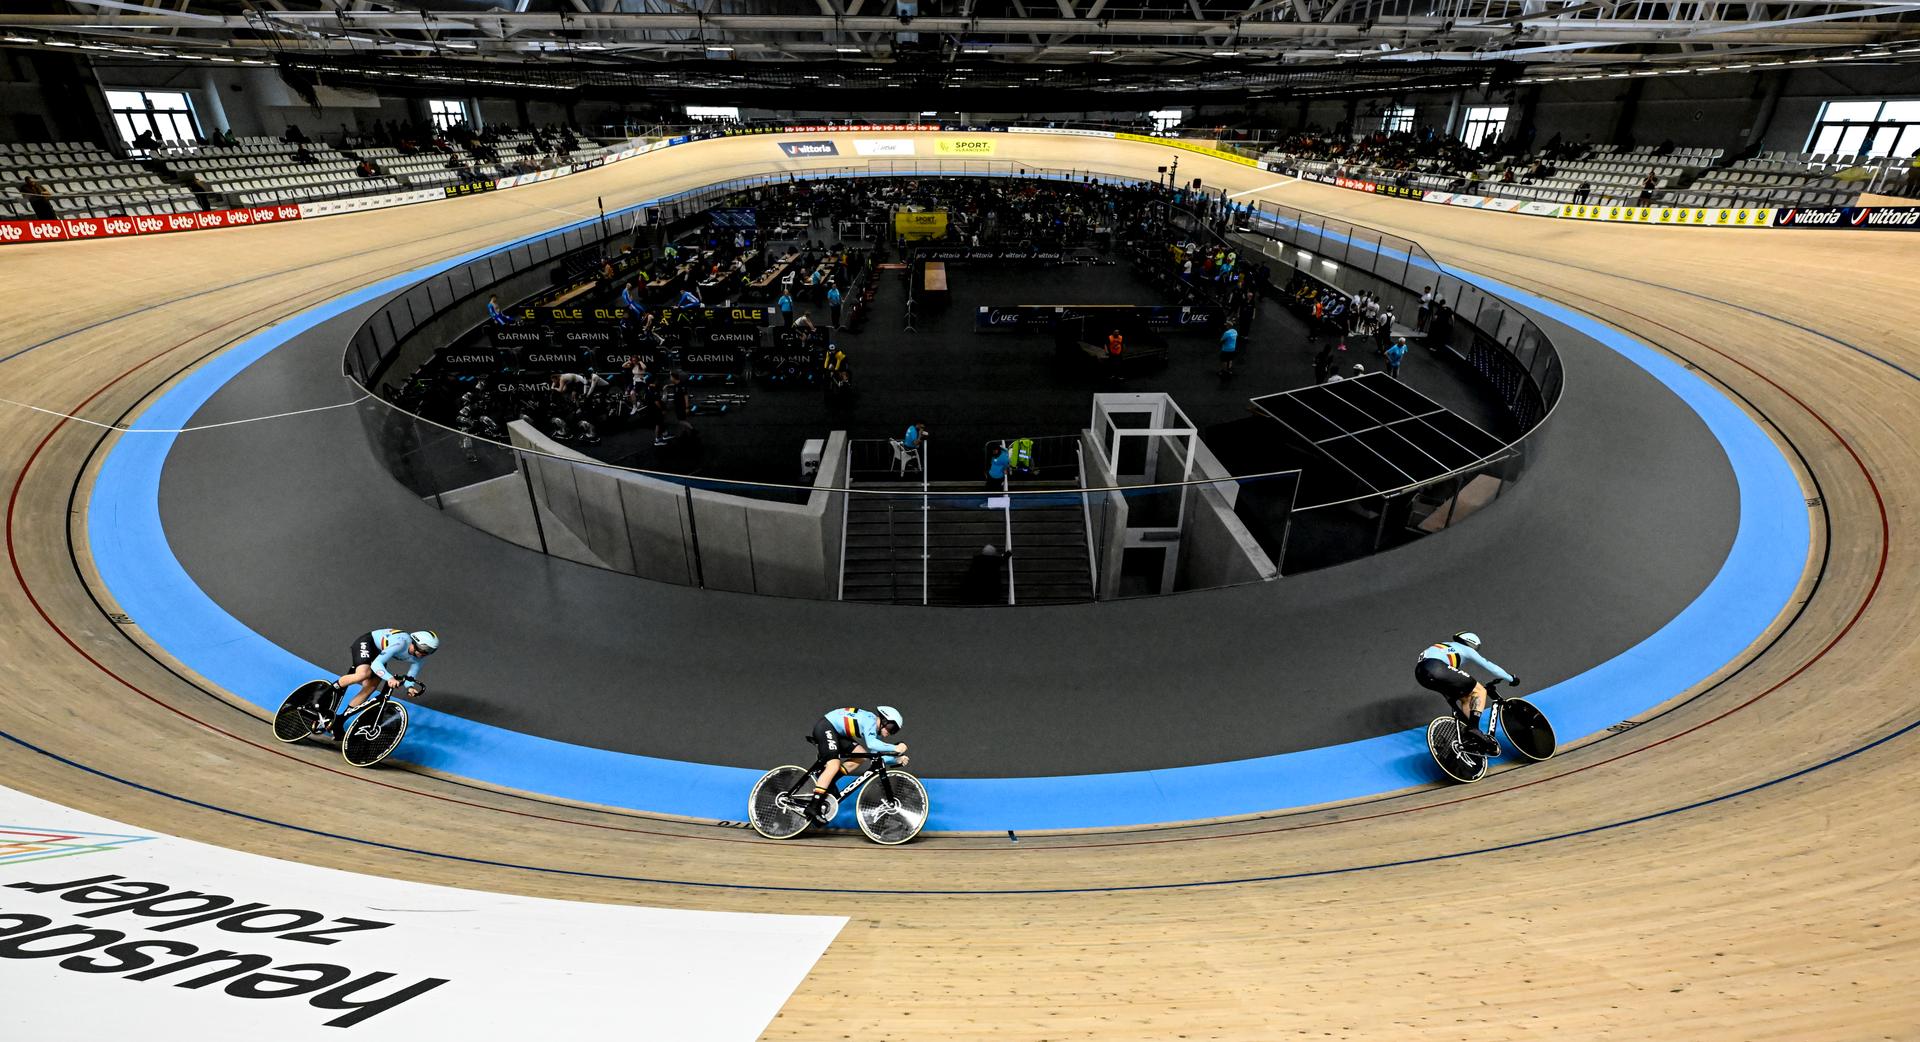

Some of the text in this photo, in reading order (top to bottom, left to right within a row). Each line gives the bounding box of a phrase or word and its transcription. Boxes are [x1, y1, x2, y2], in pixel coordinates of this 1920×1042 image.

[800, 145, 831, 153] vittoria
[1795, 208, 1920, 225] vittoria vittoria
[498, 332, 540, 341] GARMIN
[566, 332, 609, 341] GARMIN
[711, 333, 754, 342] GARMIN
[446, 355, 494, 363] GARMIN
[529, 354, 576, 362] GARMIN
[607, 354, 654, 363] GARIN
[688, 354, 734, 362] GARMIN
[4, 875, 395, 946] zolder
